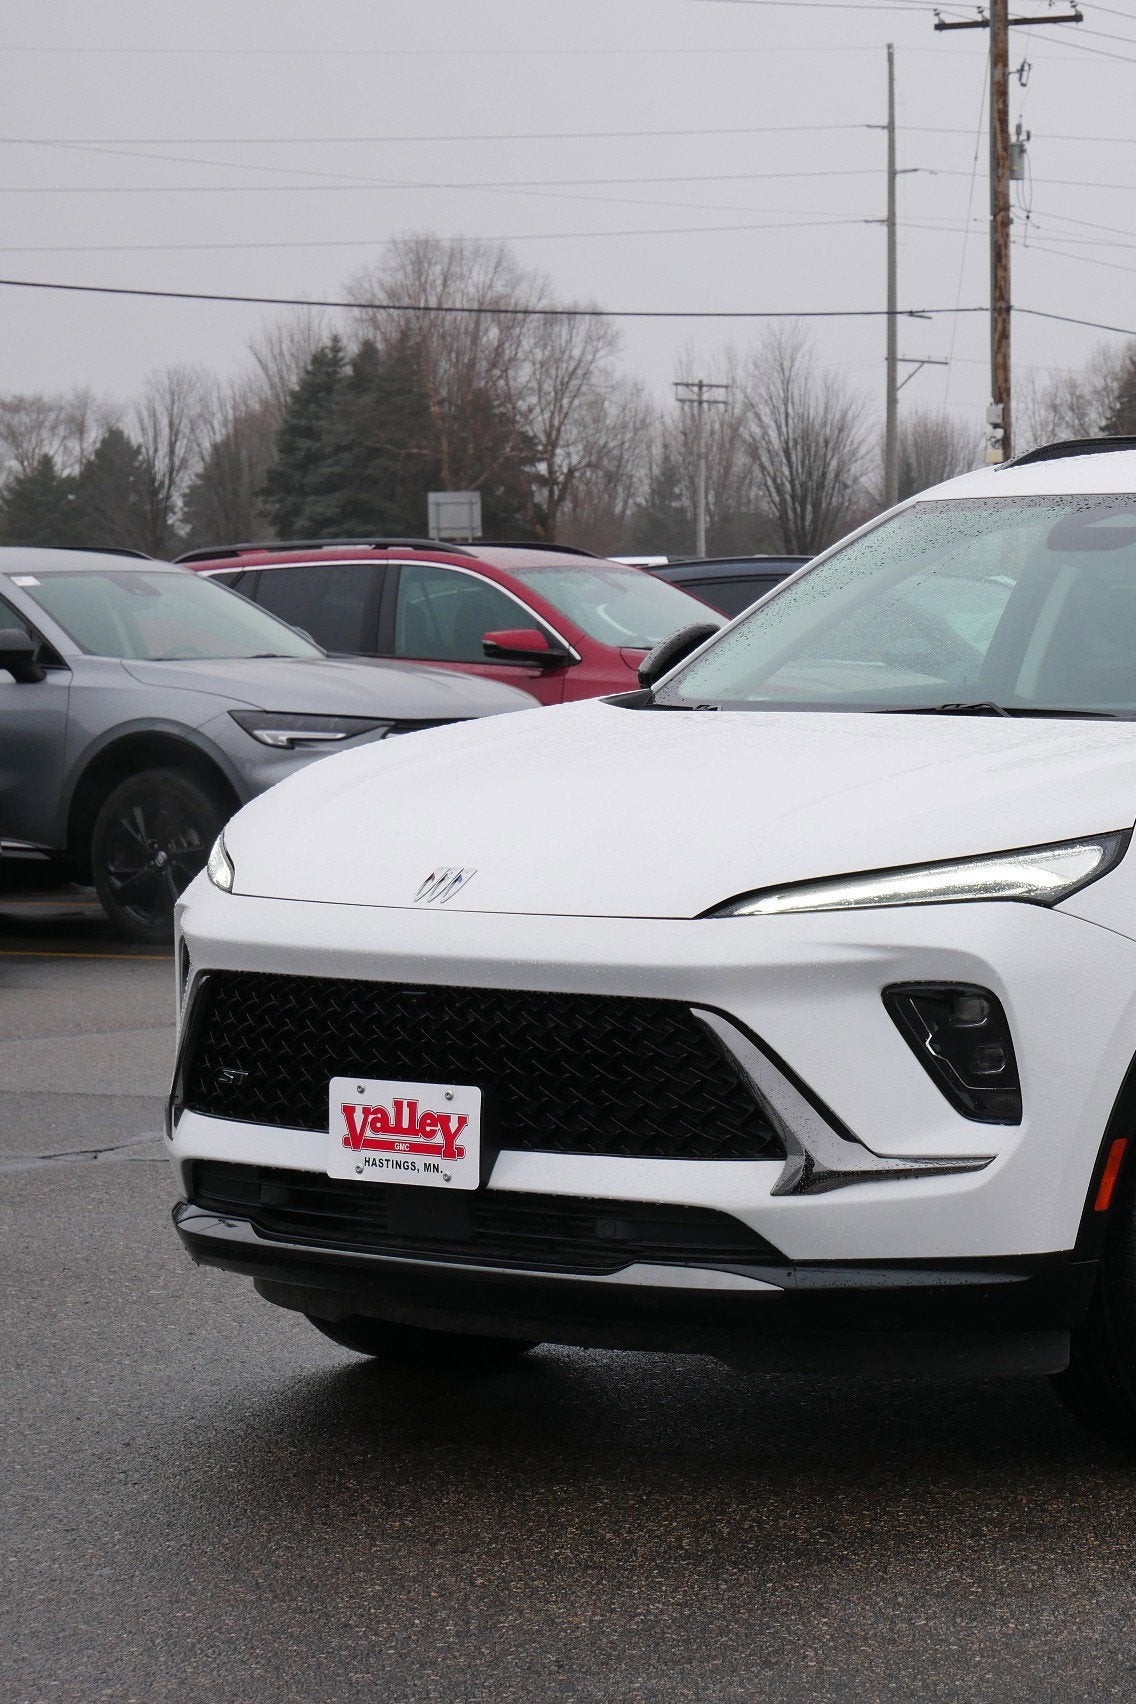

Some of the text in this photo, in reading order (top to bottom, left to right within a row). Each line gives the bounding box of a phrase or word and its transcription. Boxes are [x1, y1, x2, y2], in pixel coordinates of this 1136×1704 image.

[218, 1069, 249, 1085] ST
[341, 1098, 469, 1161] Valley
[394, 1142, 410, 1151] GMC
[364, 1156, 443, 1174] HASTINGS, MN.
